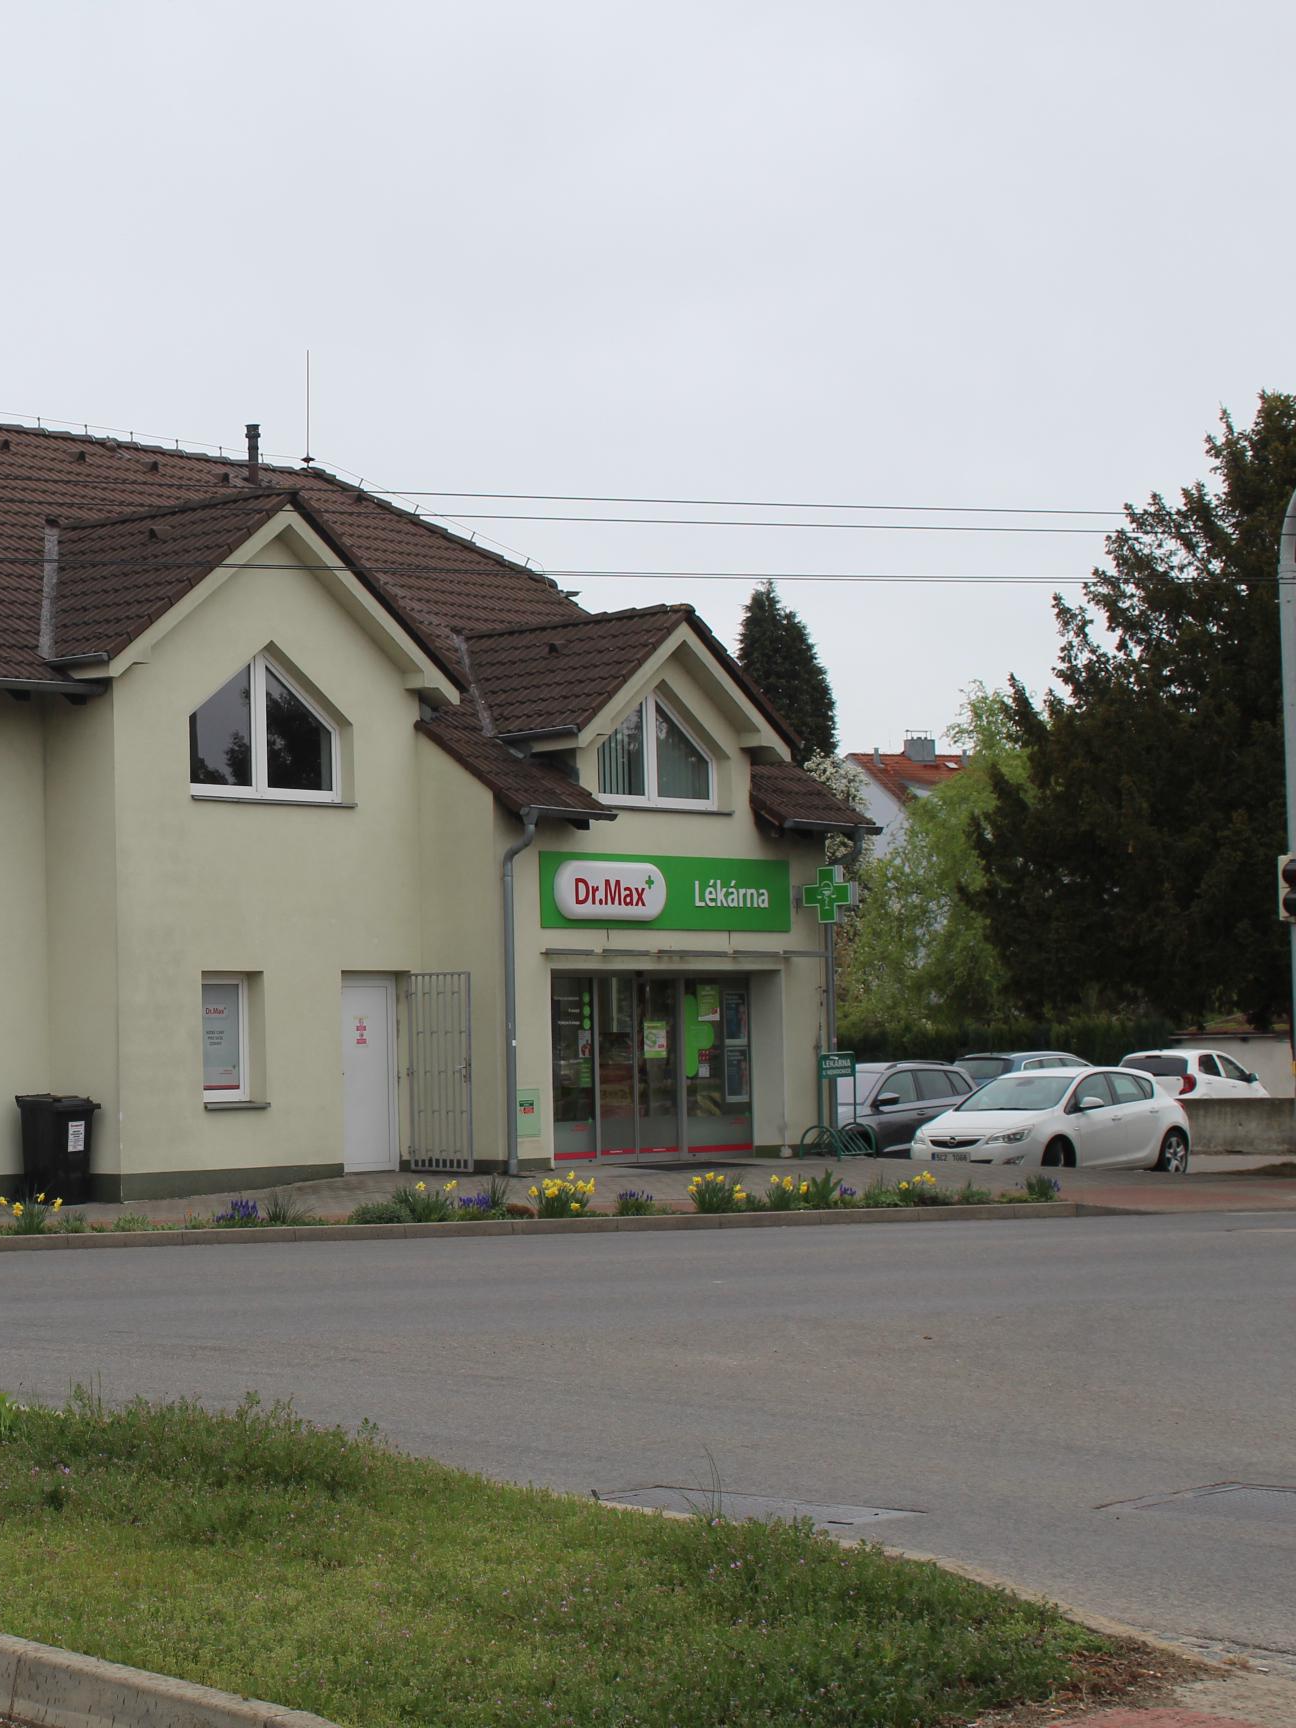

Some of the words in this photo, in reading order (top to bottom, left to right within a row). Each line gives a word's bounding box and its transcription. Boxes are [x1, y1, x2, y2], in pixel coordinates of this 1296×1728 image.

[574, 877, 646, 907] Dr.Max
[694, 879, 769, 908] Lékárna
[205, 1007, 225, 1015] Dr.Max
